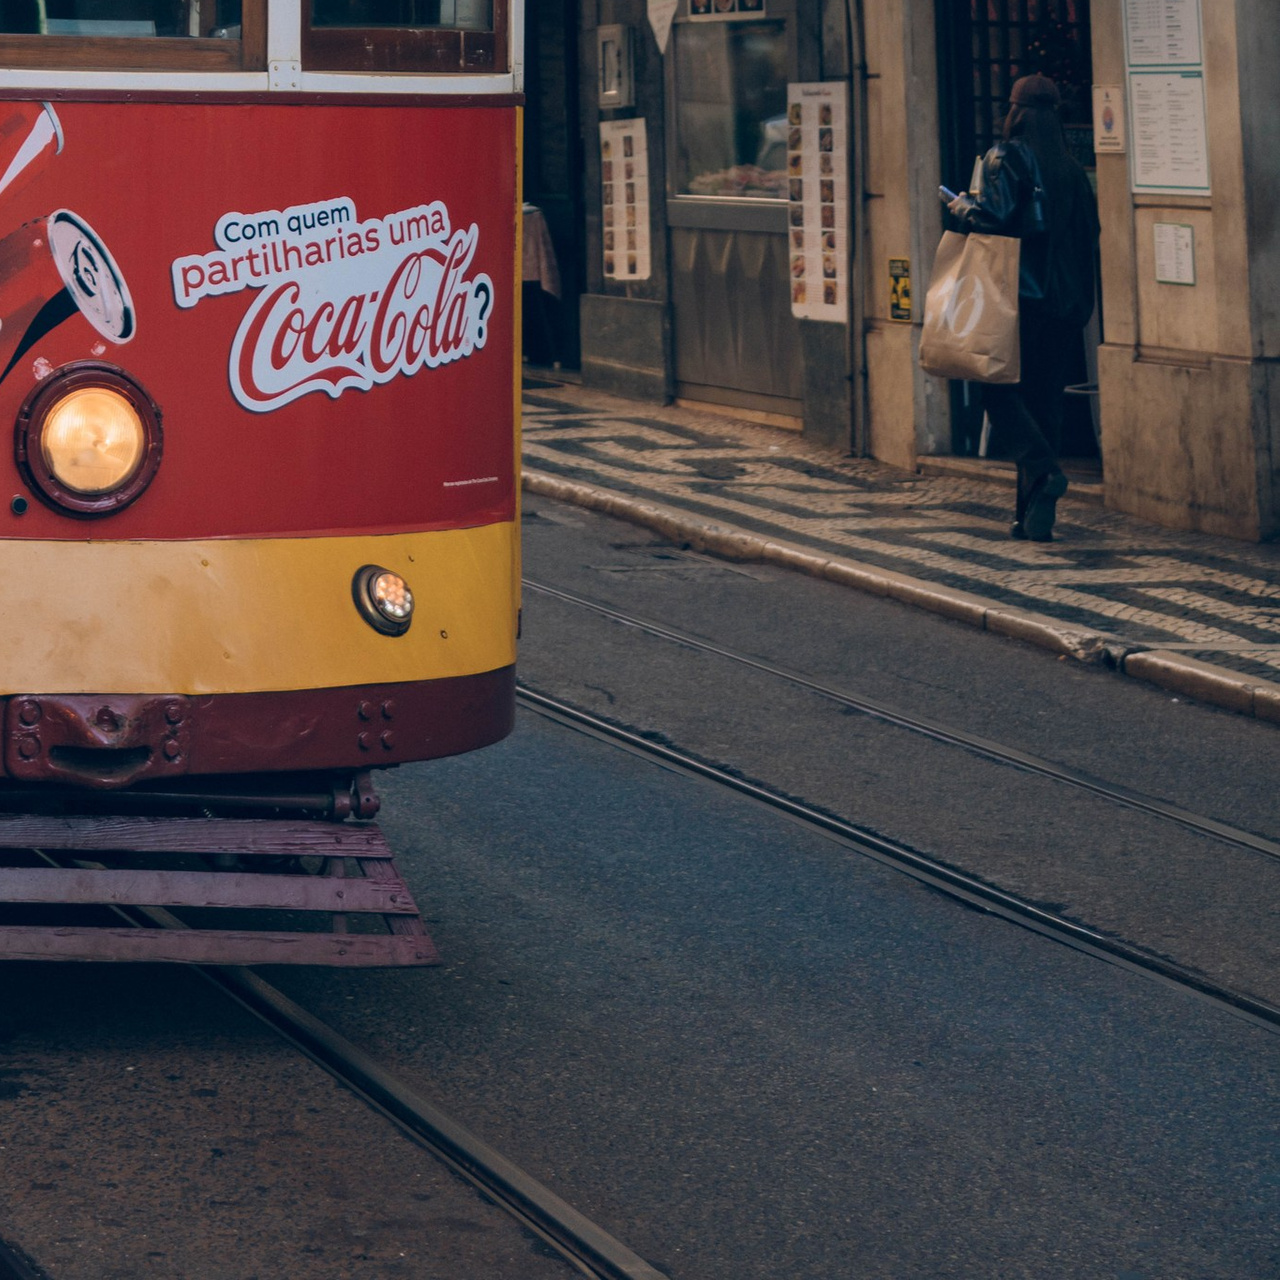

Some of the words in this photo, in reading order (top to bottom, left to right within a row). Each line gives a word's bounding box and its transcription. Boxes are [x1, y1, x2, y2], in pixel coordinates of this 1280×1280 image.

[181, 226, 381, 298] partilharias
[388, 208, 446, 246] uma
[223, 218, 280, 243] Com
[287, 205, 350, 236] quem
